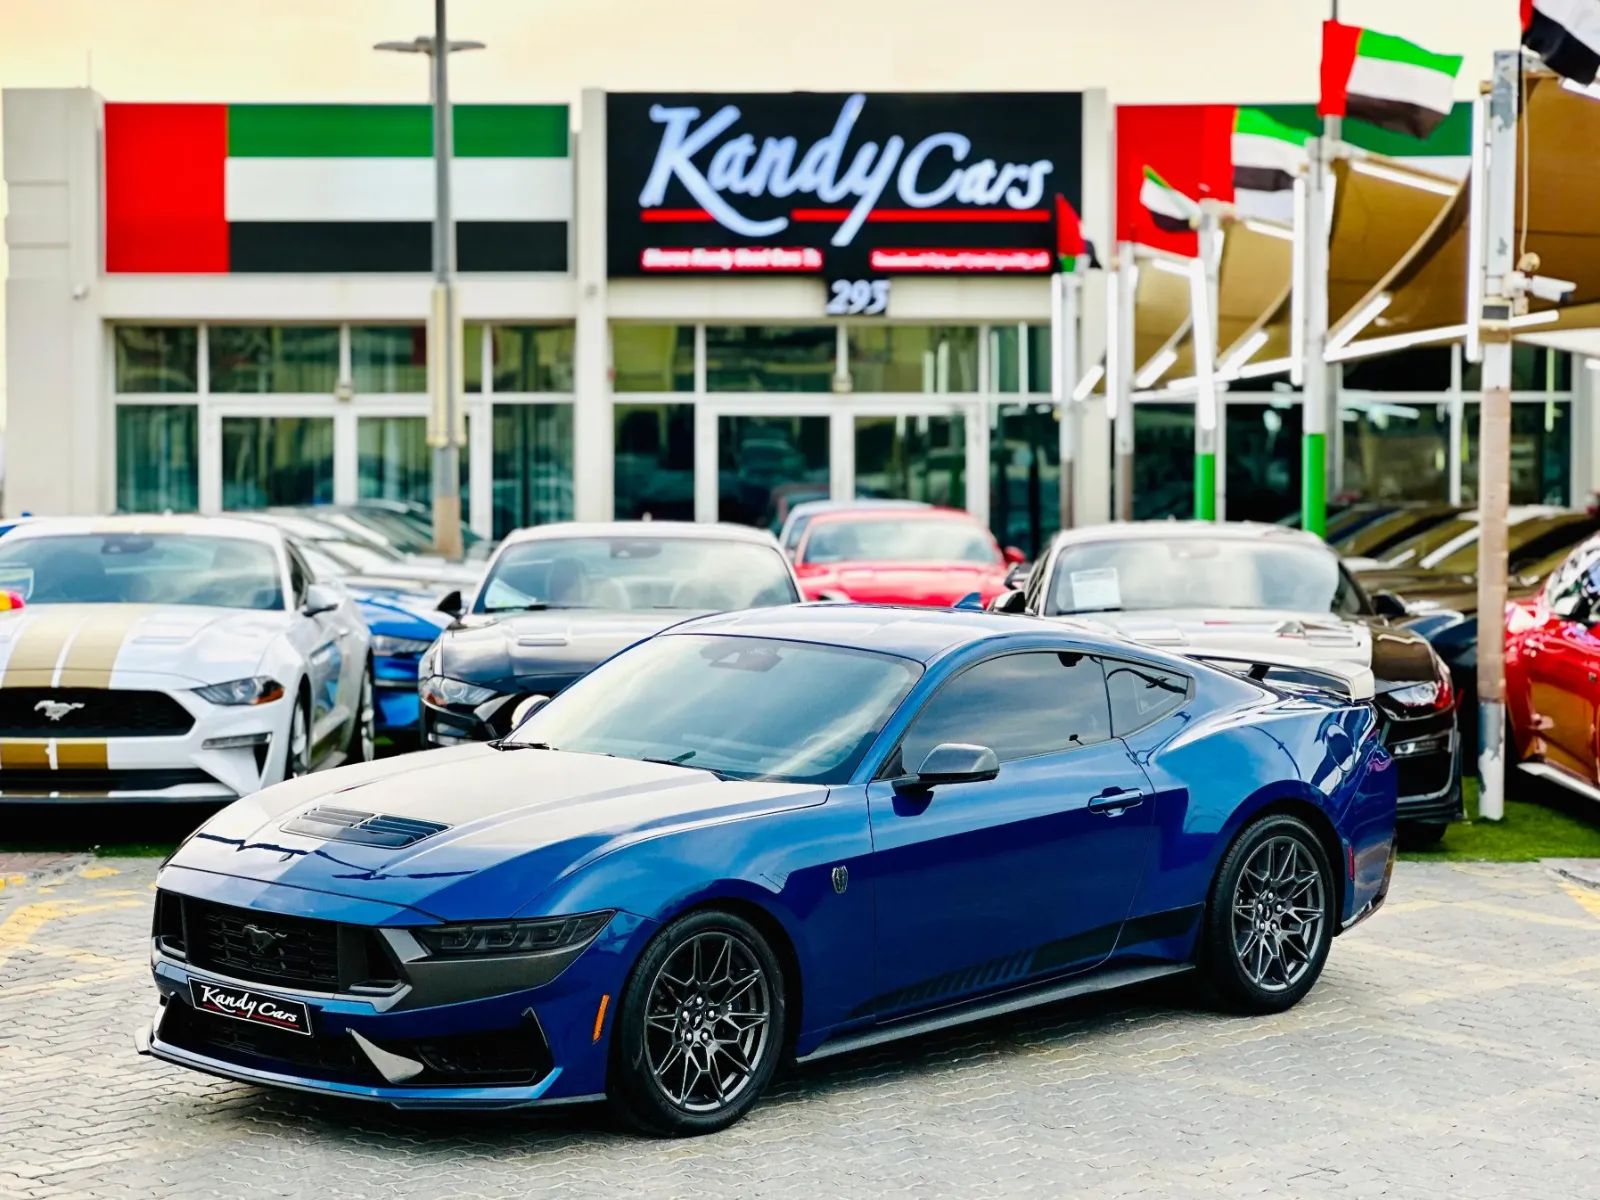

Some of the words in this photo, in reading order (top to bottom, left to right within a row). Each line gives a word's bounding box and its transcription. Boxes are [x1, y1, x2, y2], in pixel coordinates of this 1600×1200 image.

[638, 93, 904, 246] Kandy
[898, 132, 1053, 209] Cars
[827, 279, 892, 315] 295
[200, 984, 257, 1018] Kandy
[258, 1002, 298, 1023] Cars
